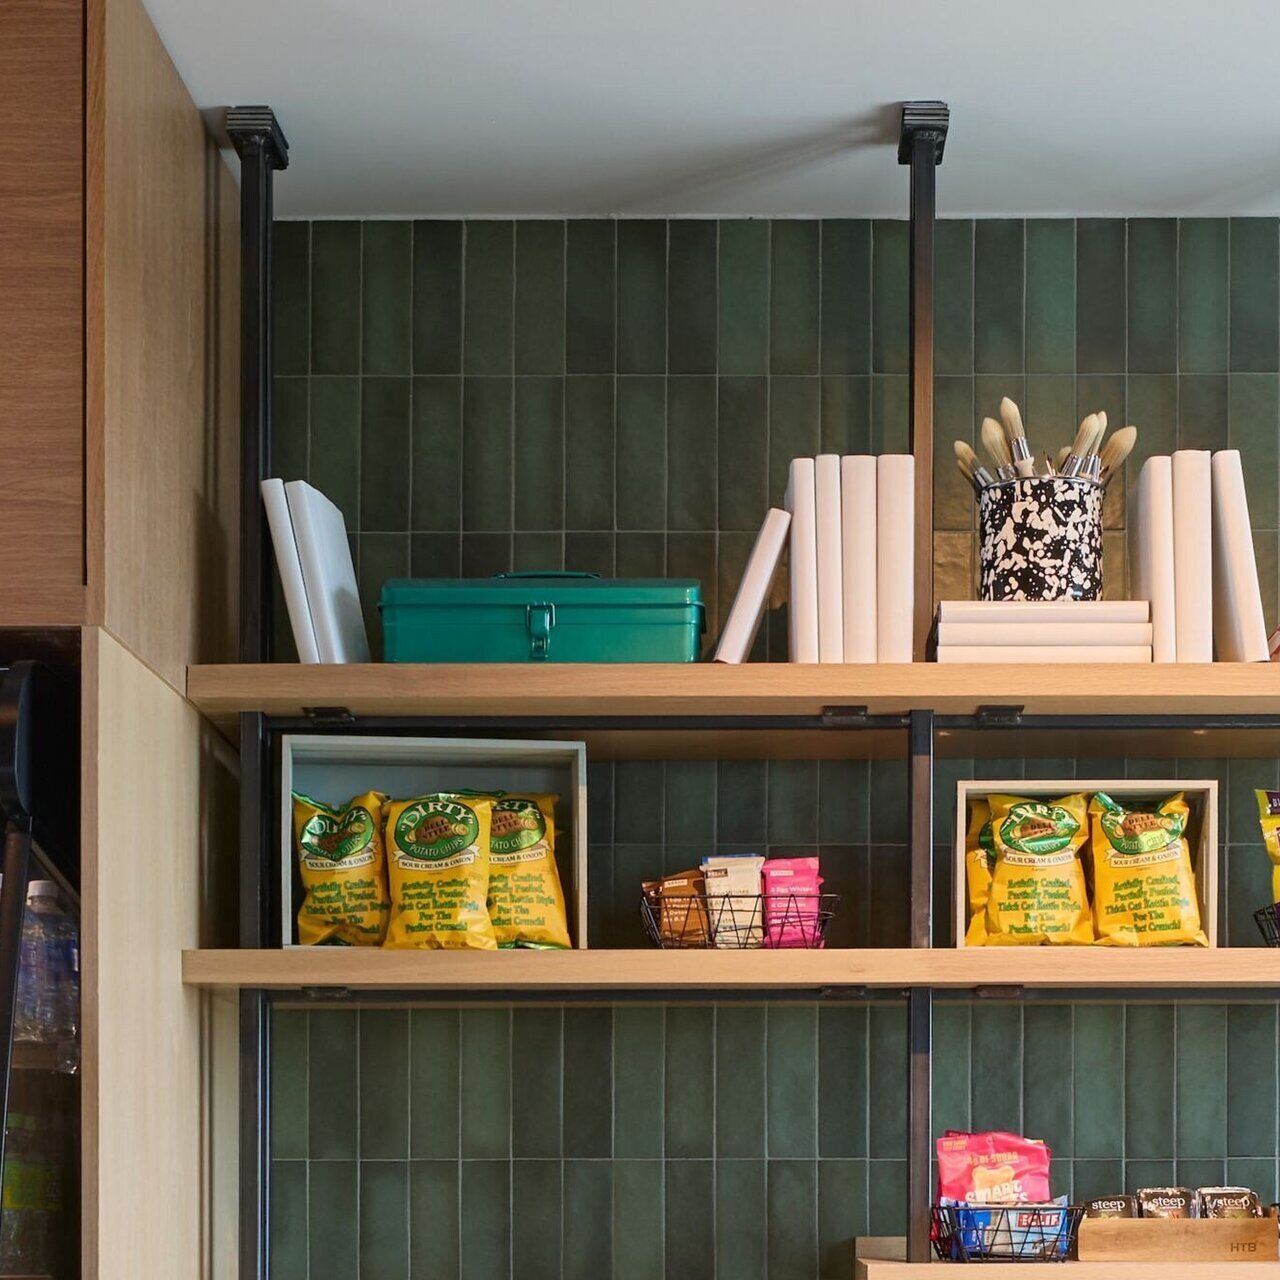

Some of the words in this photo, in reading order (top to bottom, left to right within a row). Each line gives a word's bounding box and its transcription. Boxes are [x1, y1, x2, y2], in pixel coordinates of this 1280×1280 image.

[1128, 815, 1151, 826] DELI
[410, 843, 439, 856] POTATO
[441, 838, 463, 855] CHIPS
[421, 861, 443, 869] CREAM
[1006, 856, 1023, 864] SOUR
[1133, 912, 1147, 921] For
[1148, 910, 1164, 920] The
[1092, 1199, 1126, 1212] steep
[1152, 1196, 1186, 1209] steep
[1217, 1195, 1250, 1210] steep
[1230, 1242, 1257, 1252] HTB
